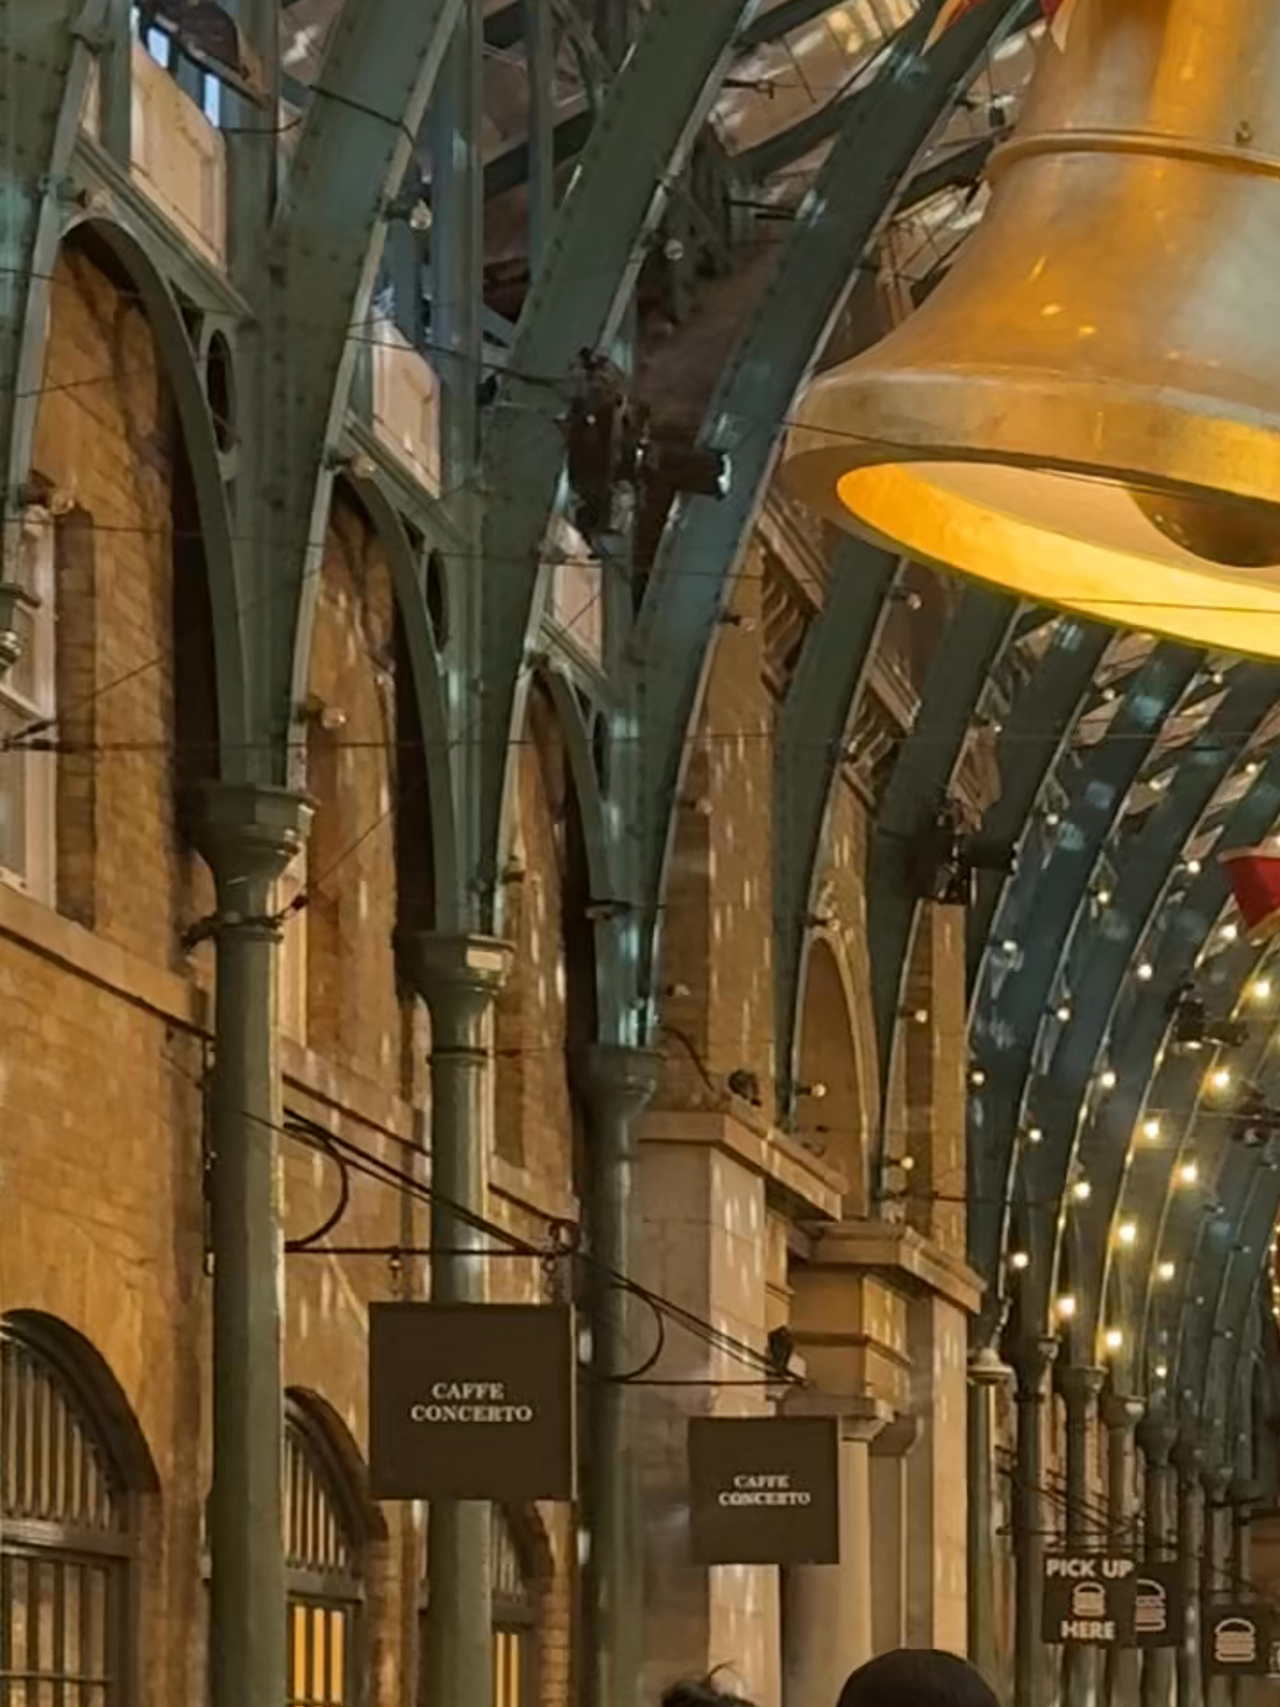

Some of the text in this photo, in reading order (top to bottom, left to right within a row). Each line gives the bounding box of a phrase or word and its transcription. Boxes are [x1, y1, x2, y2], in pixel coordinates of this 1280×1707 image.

[431, 1383, 504, 1399] CAFFE
[410, 1405, 533, 1423] CONCERTO
[719, 1491, 811, 1506] CONCERTO
[1046, 1558, 1134, 1577] PICK UP
[1061, 1621, 1116, 1640] HERE
